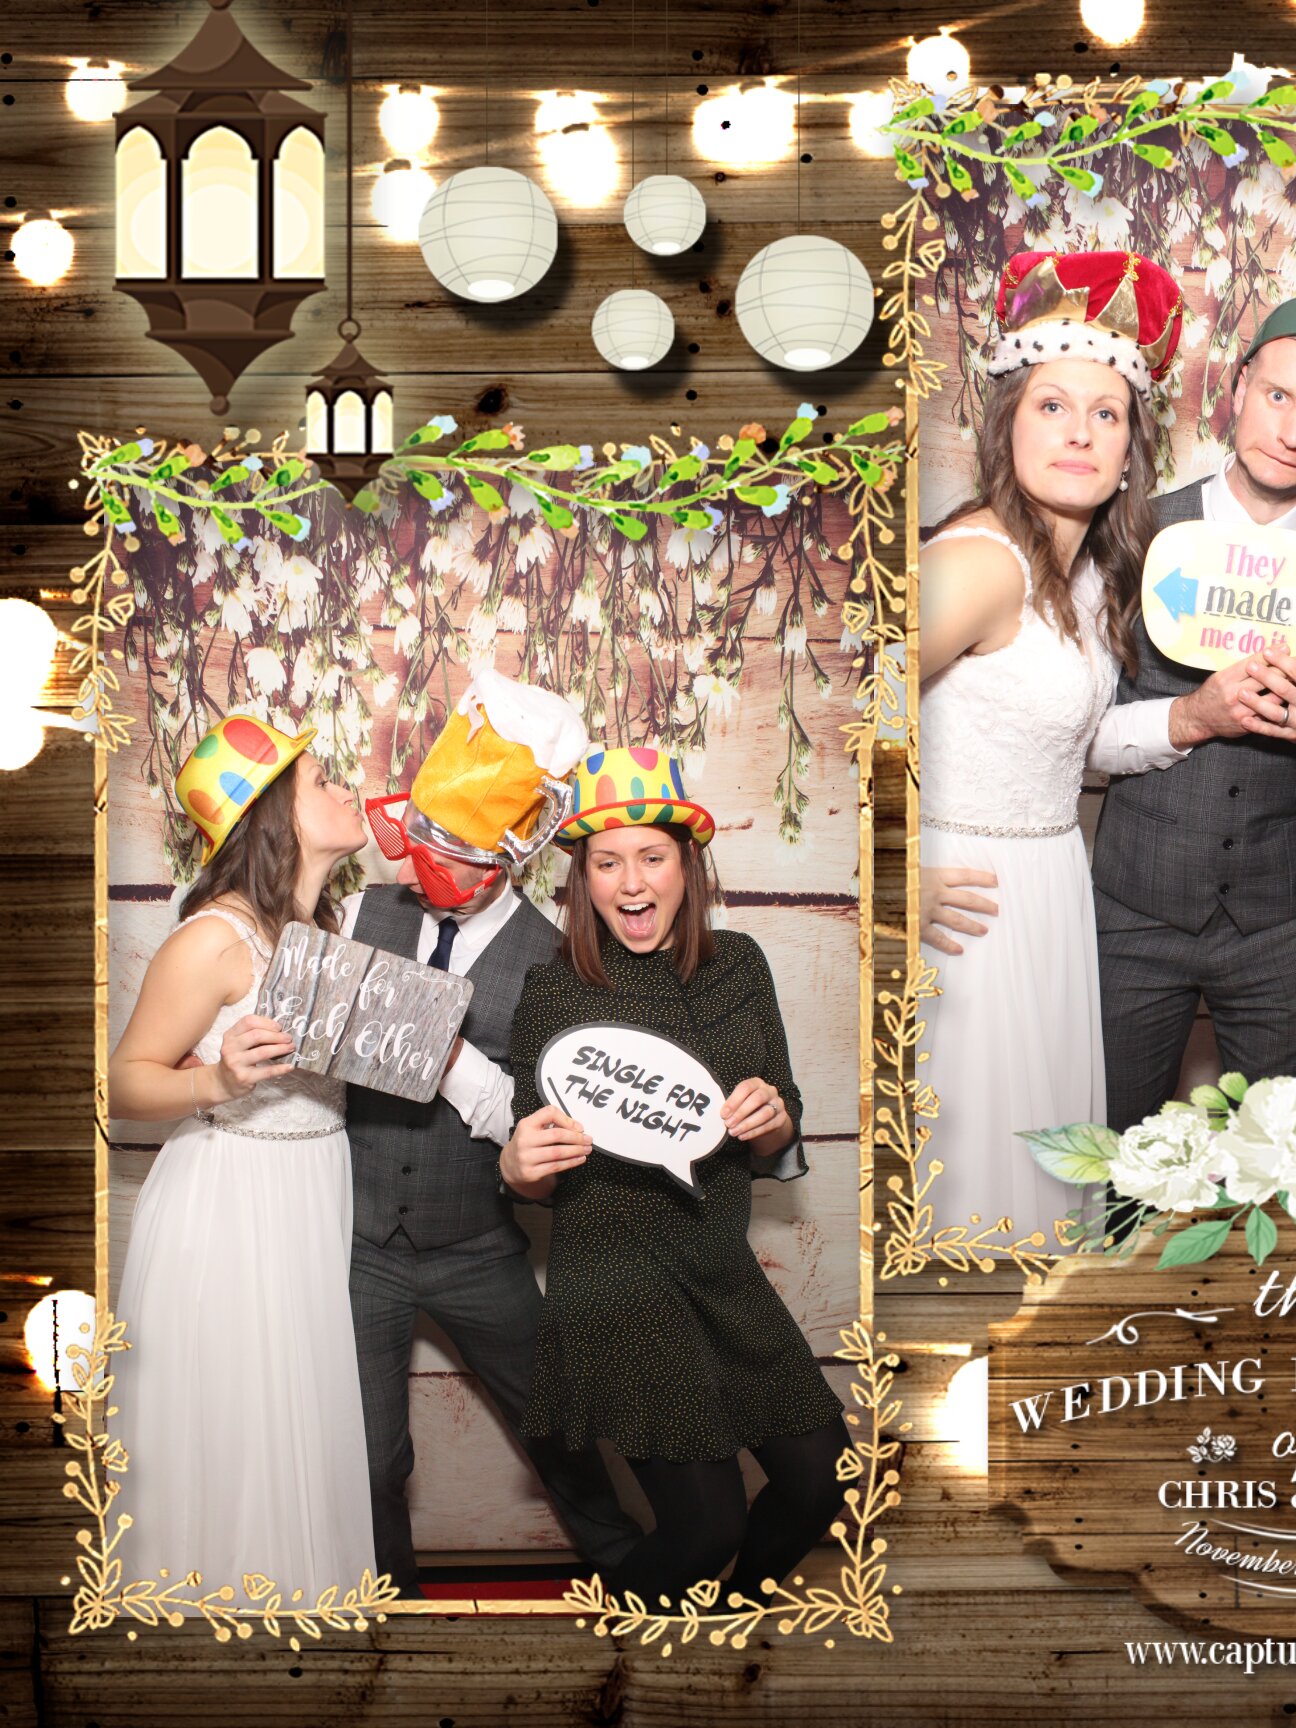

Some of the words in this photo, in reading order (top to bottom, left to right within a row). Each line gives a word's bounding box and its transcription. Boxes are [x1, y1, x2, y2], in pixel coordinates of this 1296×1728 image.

[1225, 543, 1286, 585] They
[1205, 585, 1293, 622] made
[1200, 627, 1235, 649] me
[1238, 629, 1266, 654] do
[280, 935, 355, 981] Made
[359, 961, 400, 1011] for
[273, 996, 350, 1055] Each
[354, 1020, 440, 1081] Other
[564, 1074, 615, 1109] THE
[615, 1097, 702, 1142] NIGHT
[571, 1045, 665, 1095] SINGLE
[665, 1084, 711, 1117] FOR
